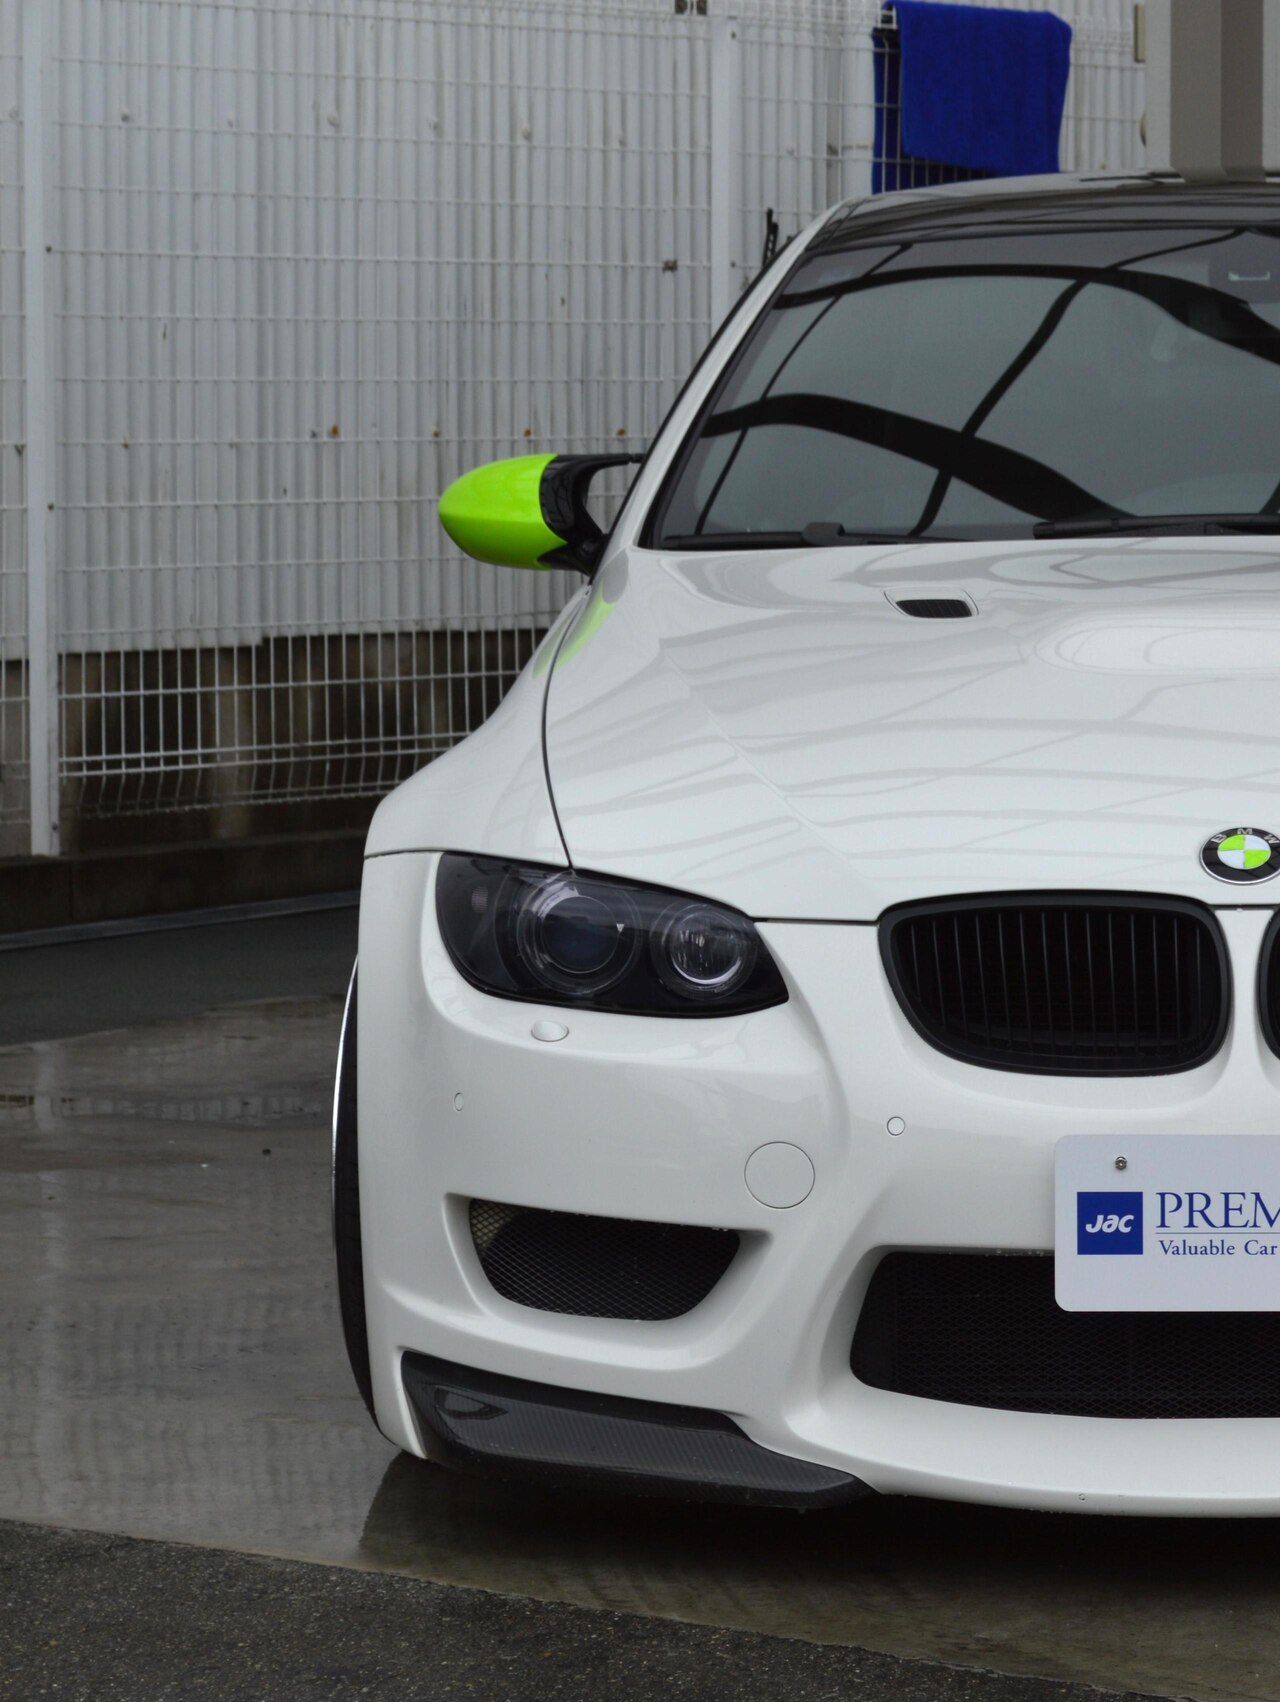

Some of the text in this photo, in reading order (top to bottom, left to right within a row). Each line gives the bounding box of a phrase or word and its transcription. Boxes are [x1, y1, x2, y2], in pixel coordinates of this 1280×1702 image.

[1211, 828, 1280, 844] BMW
[1158, 1239, 1236, 1256] Valuable
[1244, 1239, 1278, 1256] Car
